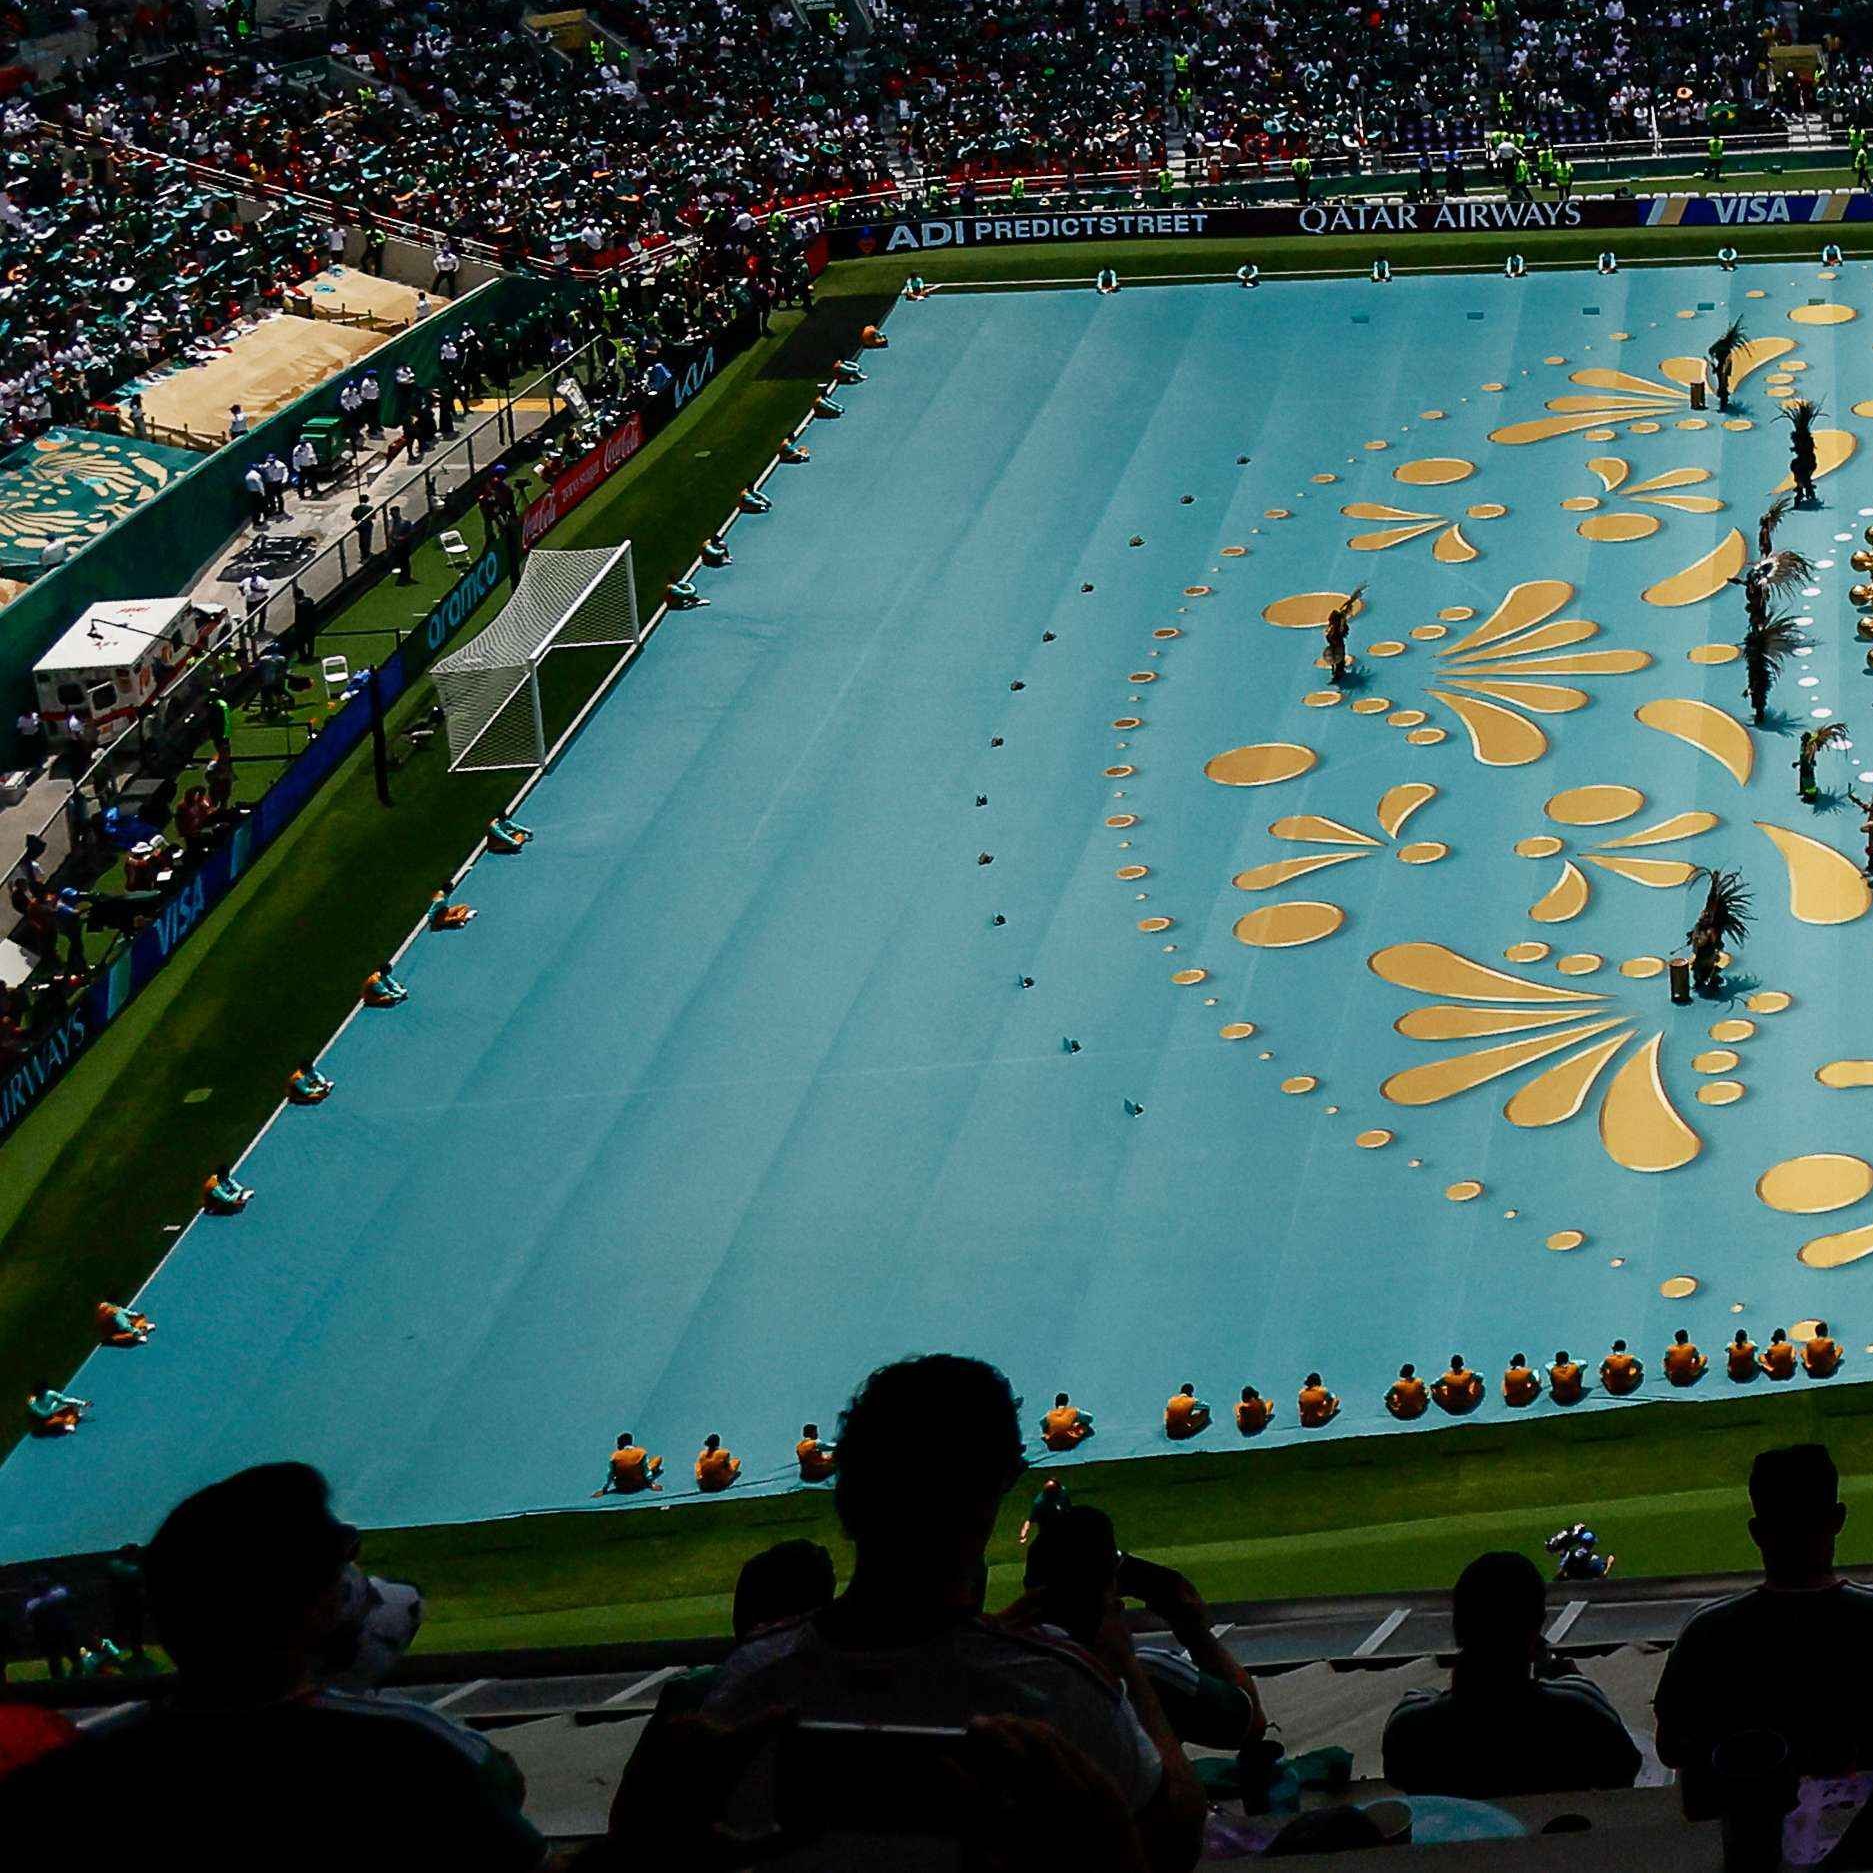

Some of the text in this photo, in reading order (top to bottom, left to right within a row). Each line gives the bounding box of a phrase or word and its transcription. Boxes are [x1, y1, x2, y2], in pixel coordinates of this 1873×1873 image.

[1299, 201, 1582, 234] QATAR AIRWAYS
[1711, 197, 1791, 224] VISA
[886, 214, 1209, 252] ADI PREDICTSTREET
[427, 550, 498, 651] aramco
[0, 1006, 87, 1130] IRWAYS
